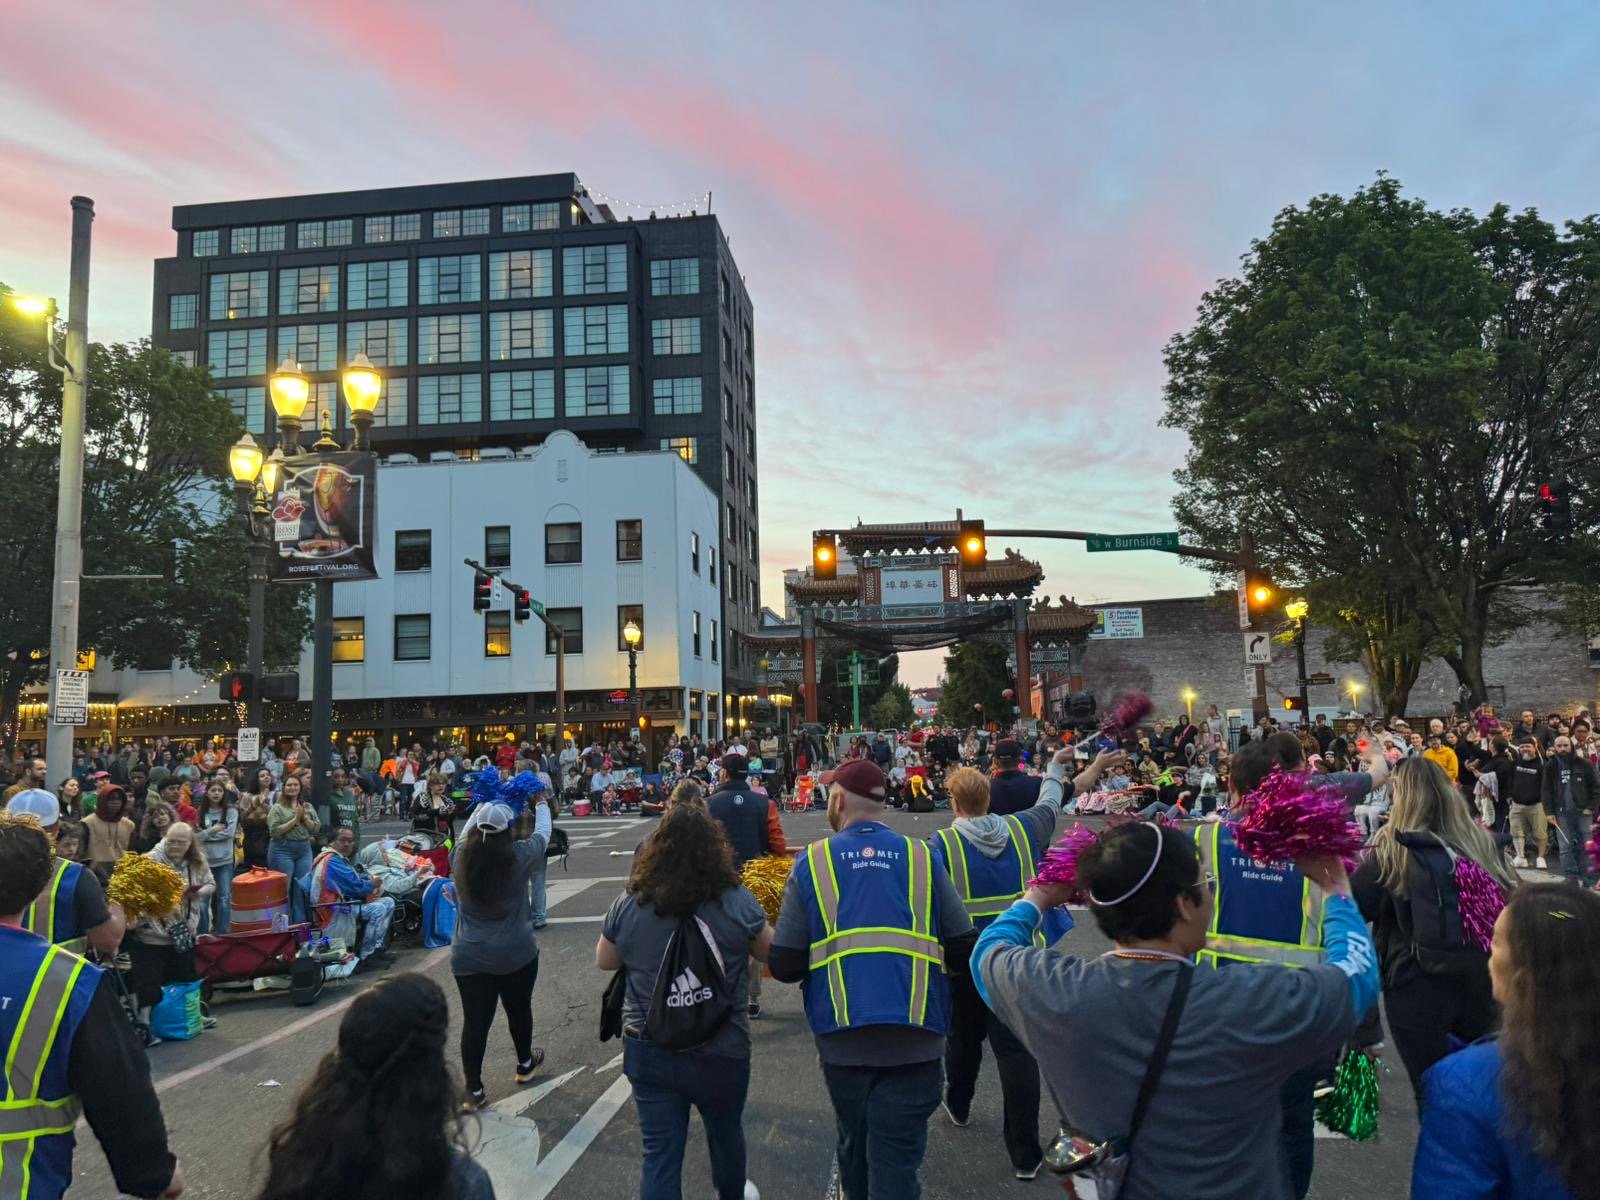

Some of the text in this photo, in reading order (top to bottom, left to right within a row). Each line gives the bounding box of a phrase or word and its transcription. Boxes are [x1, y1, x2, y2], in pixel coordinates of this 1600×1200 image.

[1115, 536, 1162, 548] Burnside
[877, 850, 900, 860] MET
[852, 860, 890, 869] Ride Guide
[1242, 870, 1284, 882] Ride Guide
